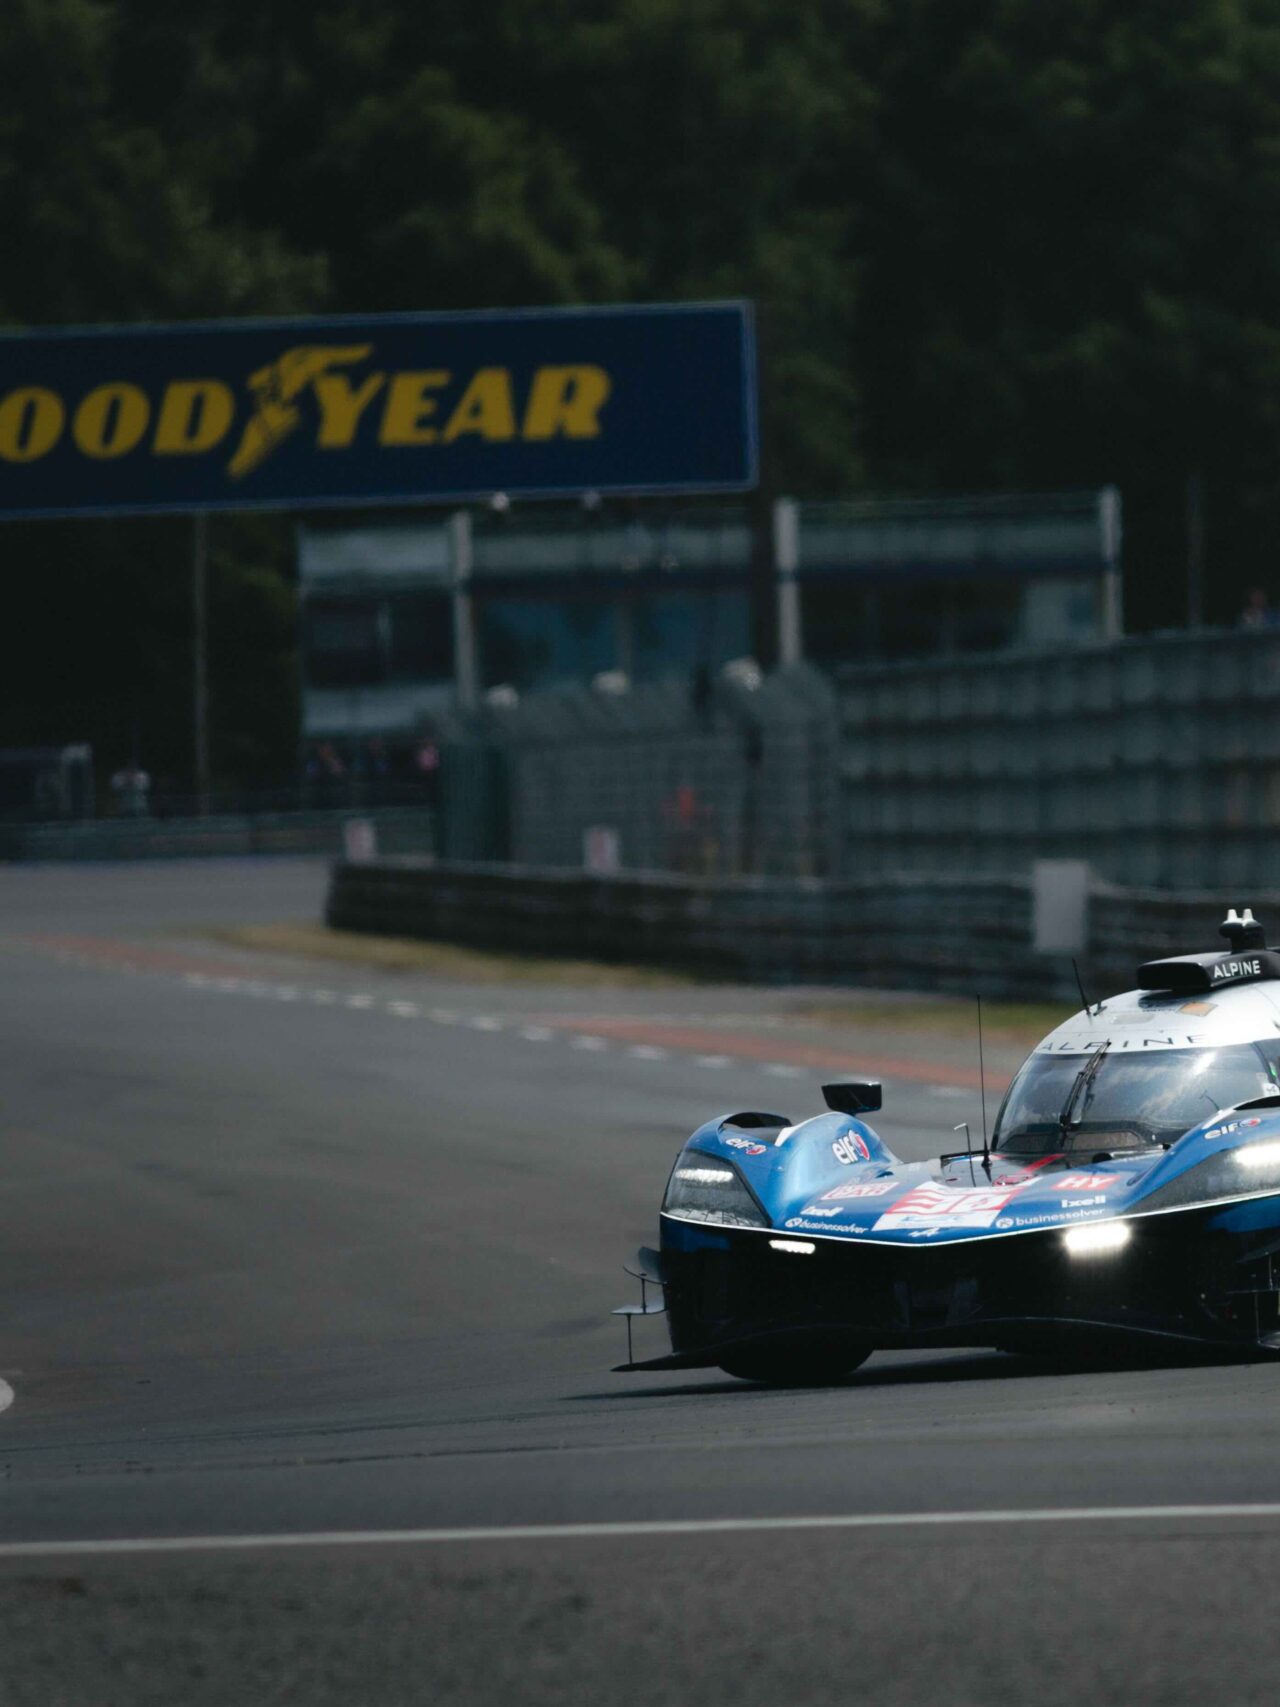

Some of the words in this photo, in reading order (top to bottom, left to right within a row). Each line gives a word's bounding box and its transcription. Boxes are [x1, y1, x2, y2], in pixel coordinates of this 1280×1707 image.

[1213, 960, 1261, 979] ALPINE
[1042, 1034, 1207, 1051] ALPINE
[1204, 1121, 1240, 1140] elf
[725, 1138, 754, 1150] elf
[832, 1133, 858, 1165] elf
[1058, 1177, 1117, 1190] HY
[800, 1219, 868, 1234] businessolver
[1016, 1209, 1105, 1228] businessolver
